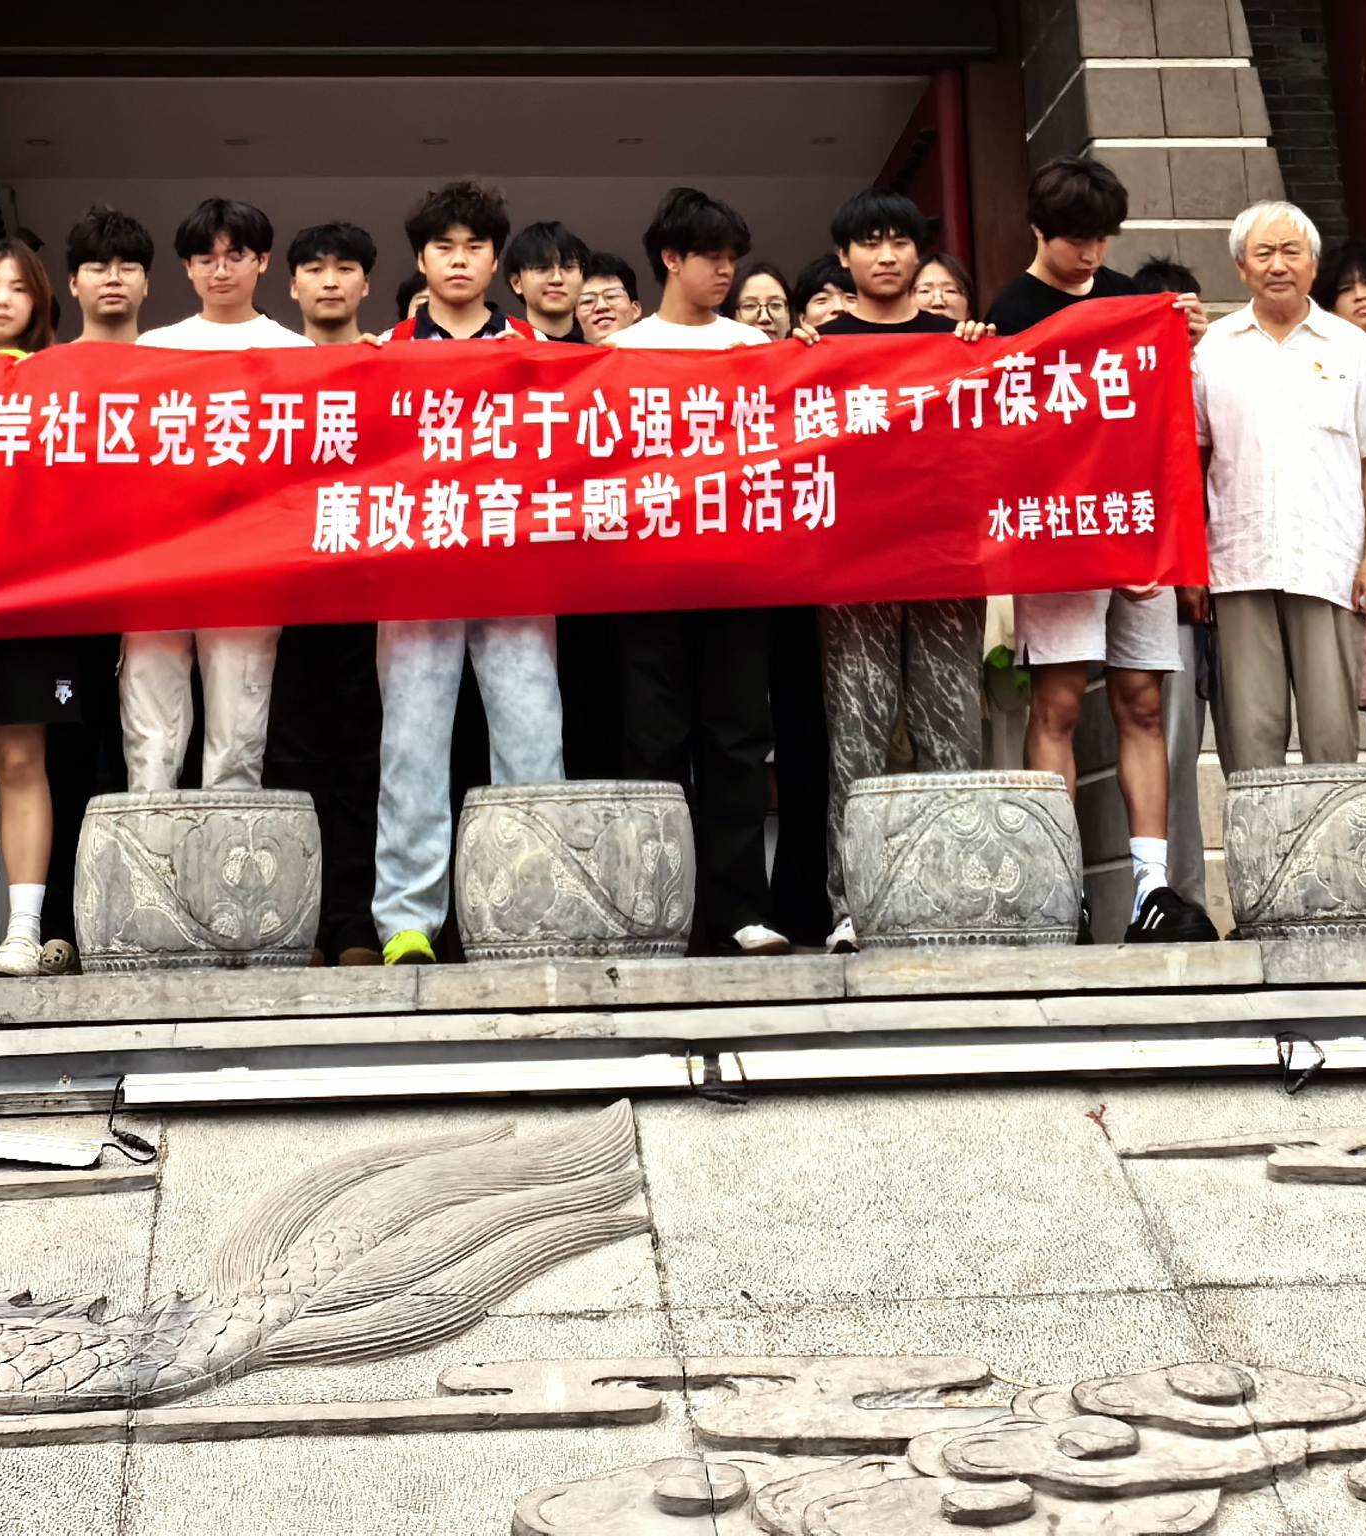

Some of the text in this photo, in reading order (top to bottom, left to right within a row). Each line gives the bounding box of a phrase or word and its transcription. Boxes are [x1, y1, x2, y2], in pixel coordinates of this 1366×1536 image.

[312, 454, 836, 554] 廉政教育主题党日活动
[988, 490, 1156, 542] 水岸社区党委
